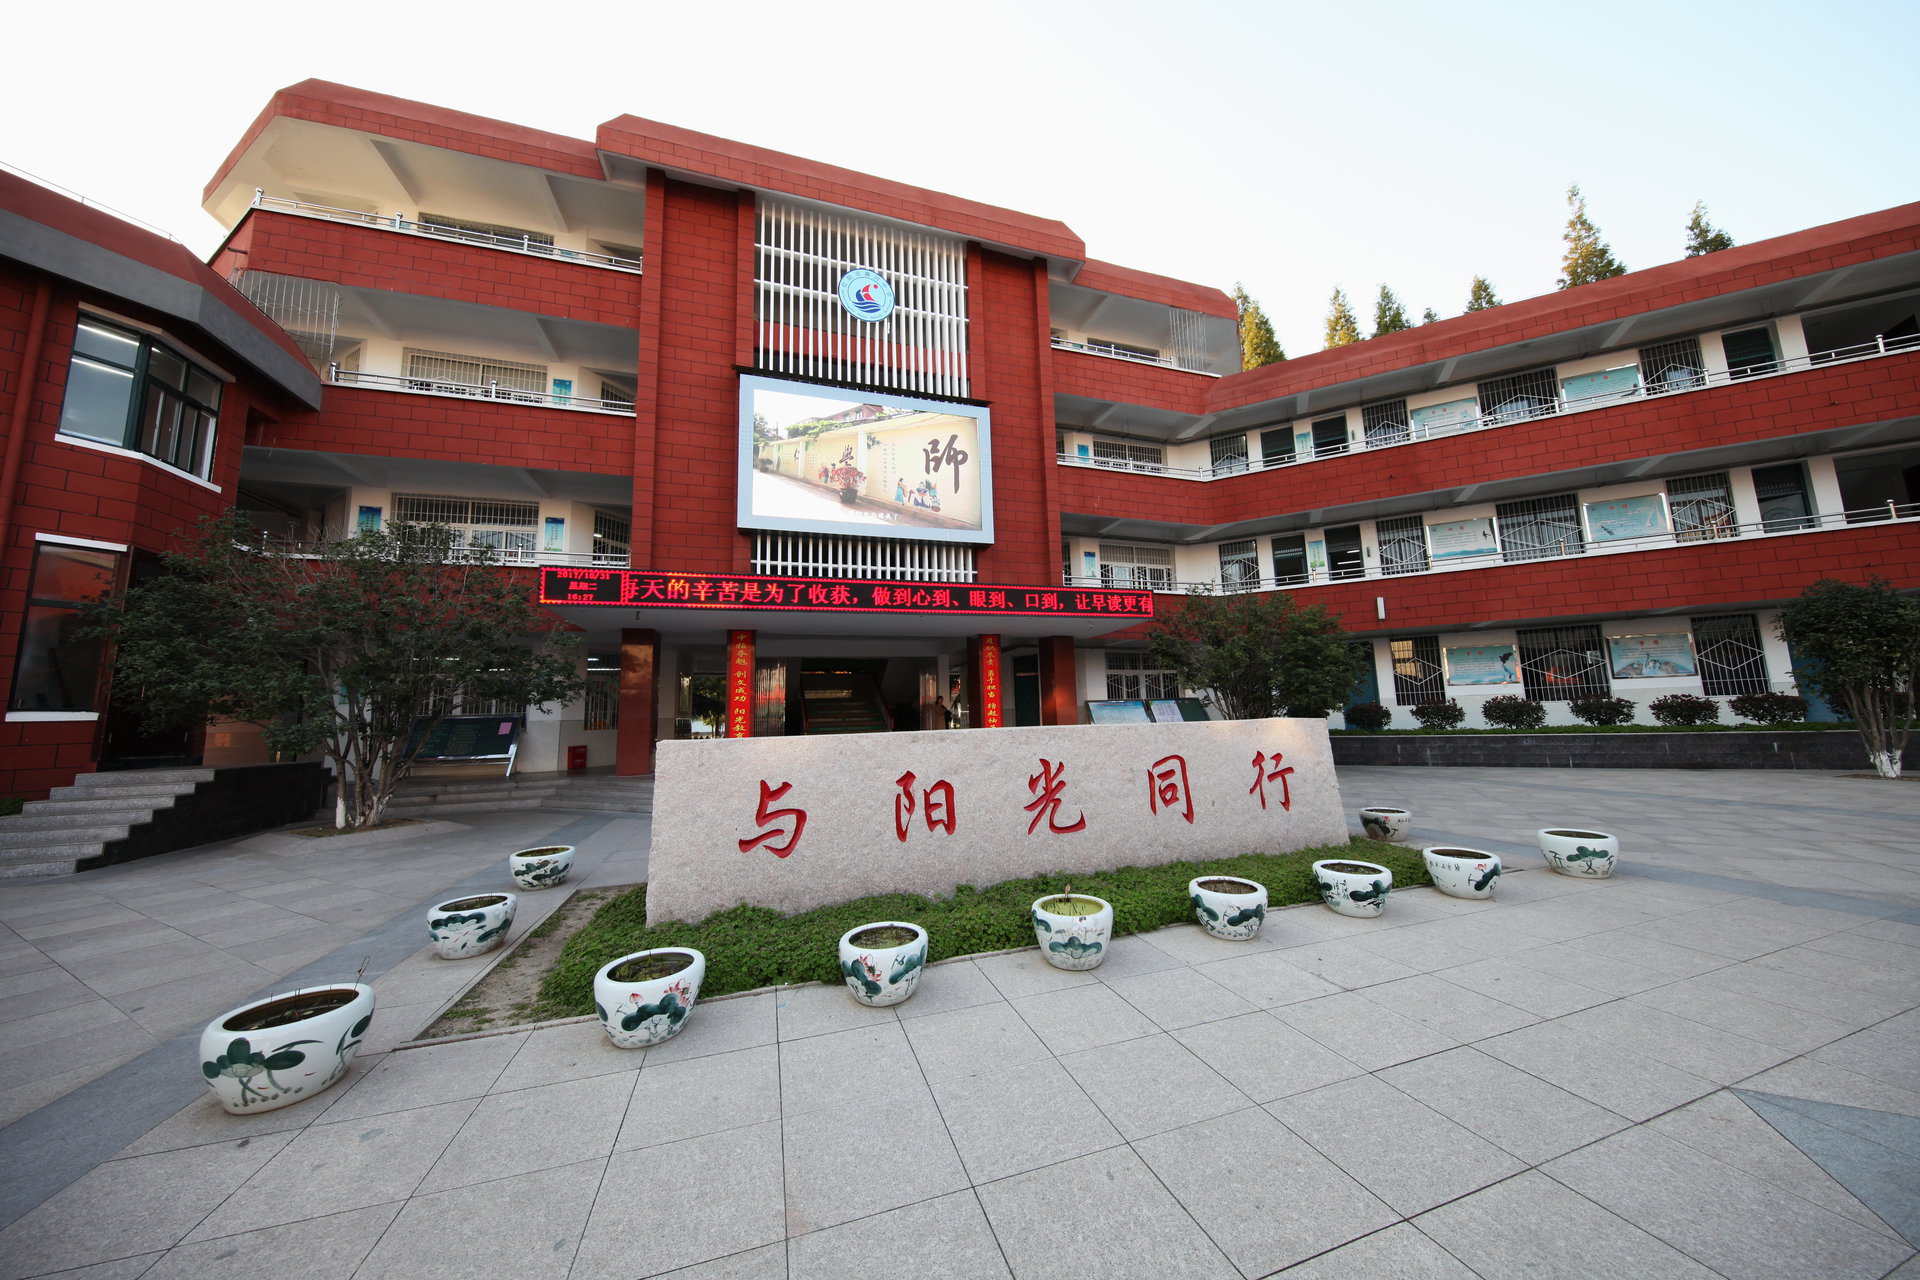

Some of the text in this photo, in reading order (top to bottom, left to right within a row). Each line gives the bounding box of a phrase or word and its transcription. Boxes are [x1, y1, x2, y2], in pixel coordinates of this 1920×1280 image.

[556, 571, 611, 580] 2017/10/31
[568, 581, 598, 591] 星期二
[567, 593, 595, 601] 16:27
[733, 670, 747, 702] 创文成功
[738, 750, 1295, 859] 与阳光同行
